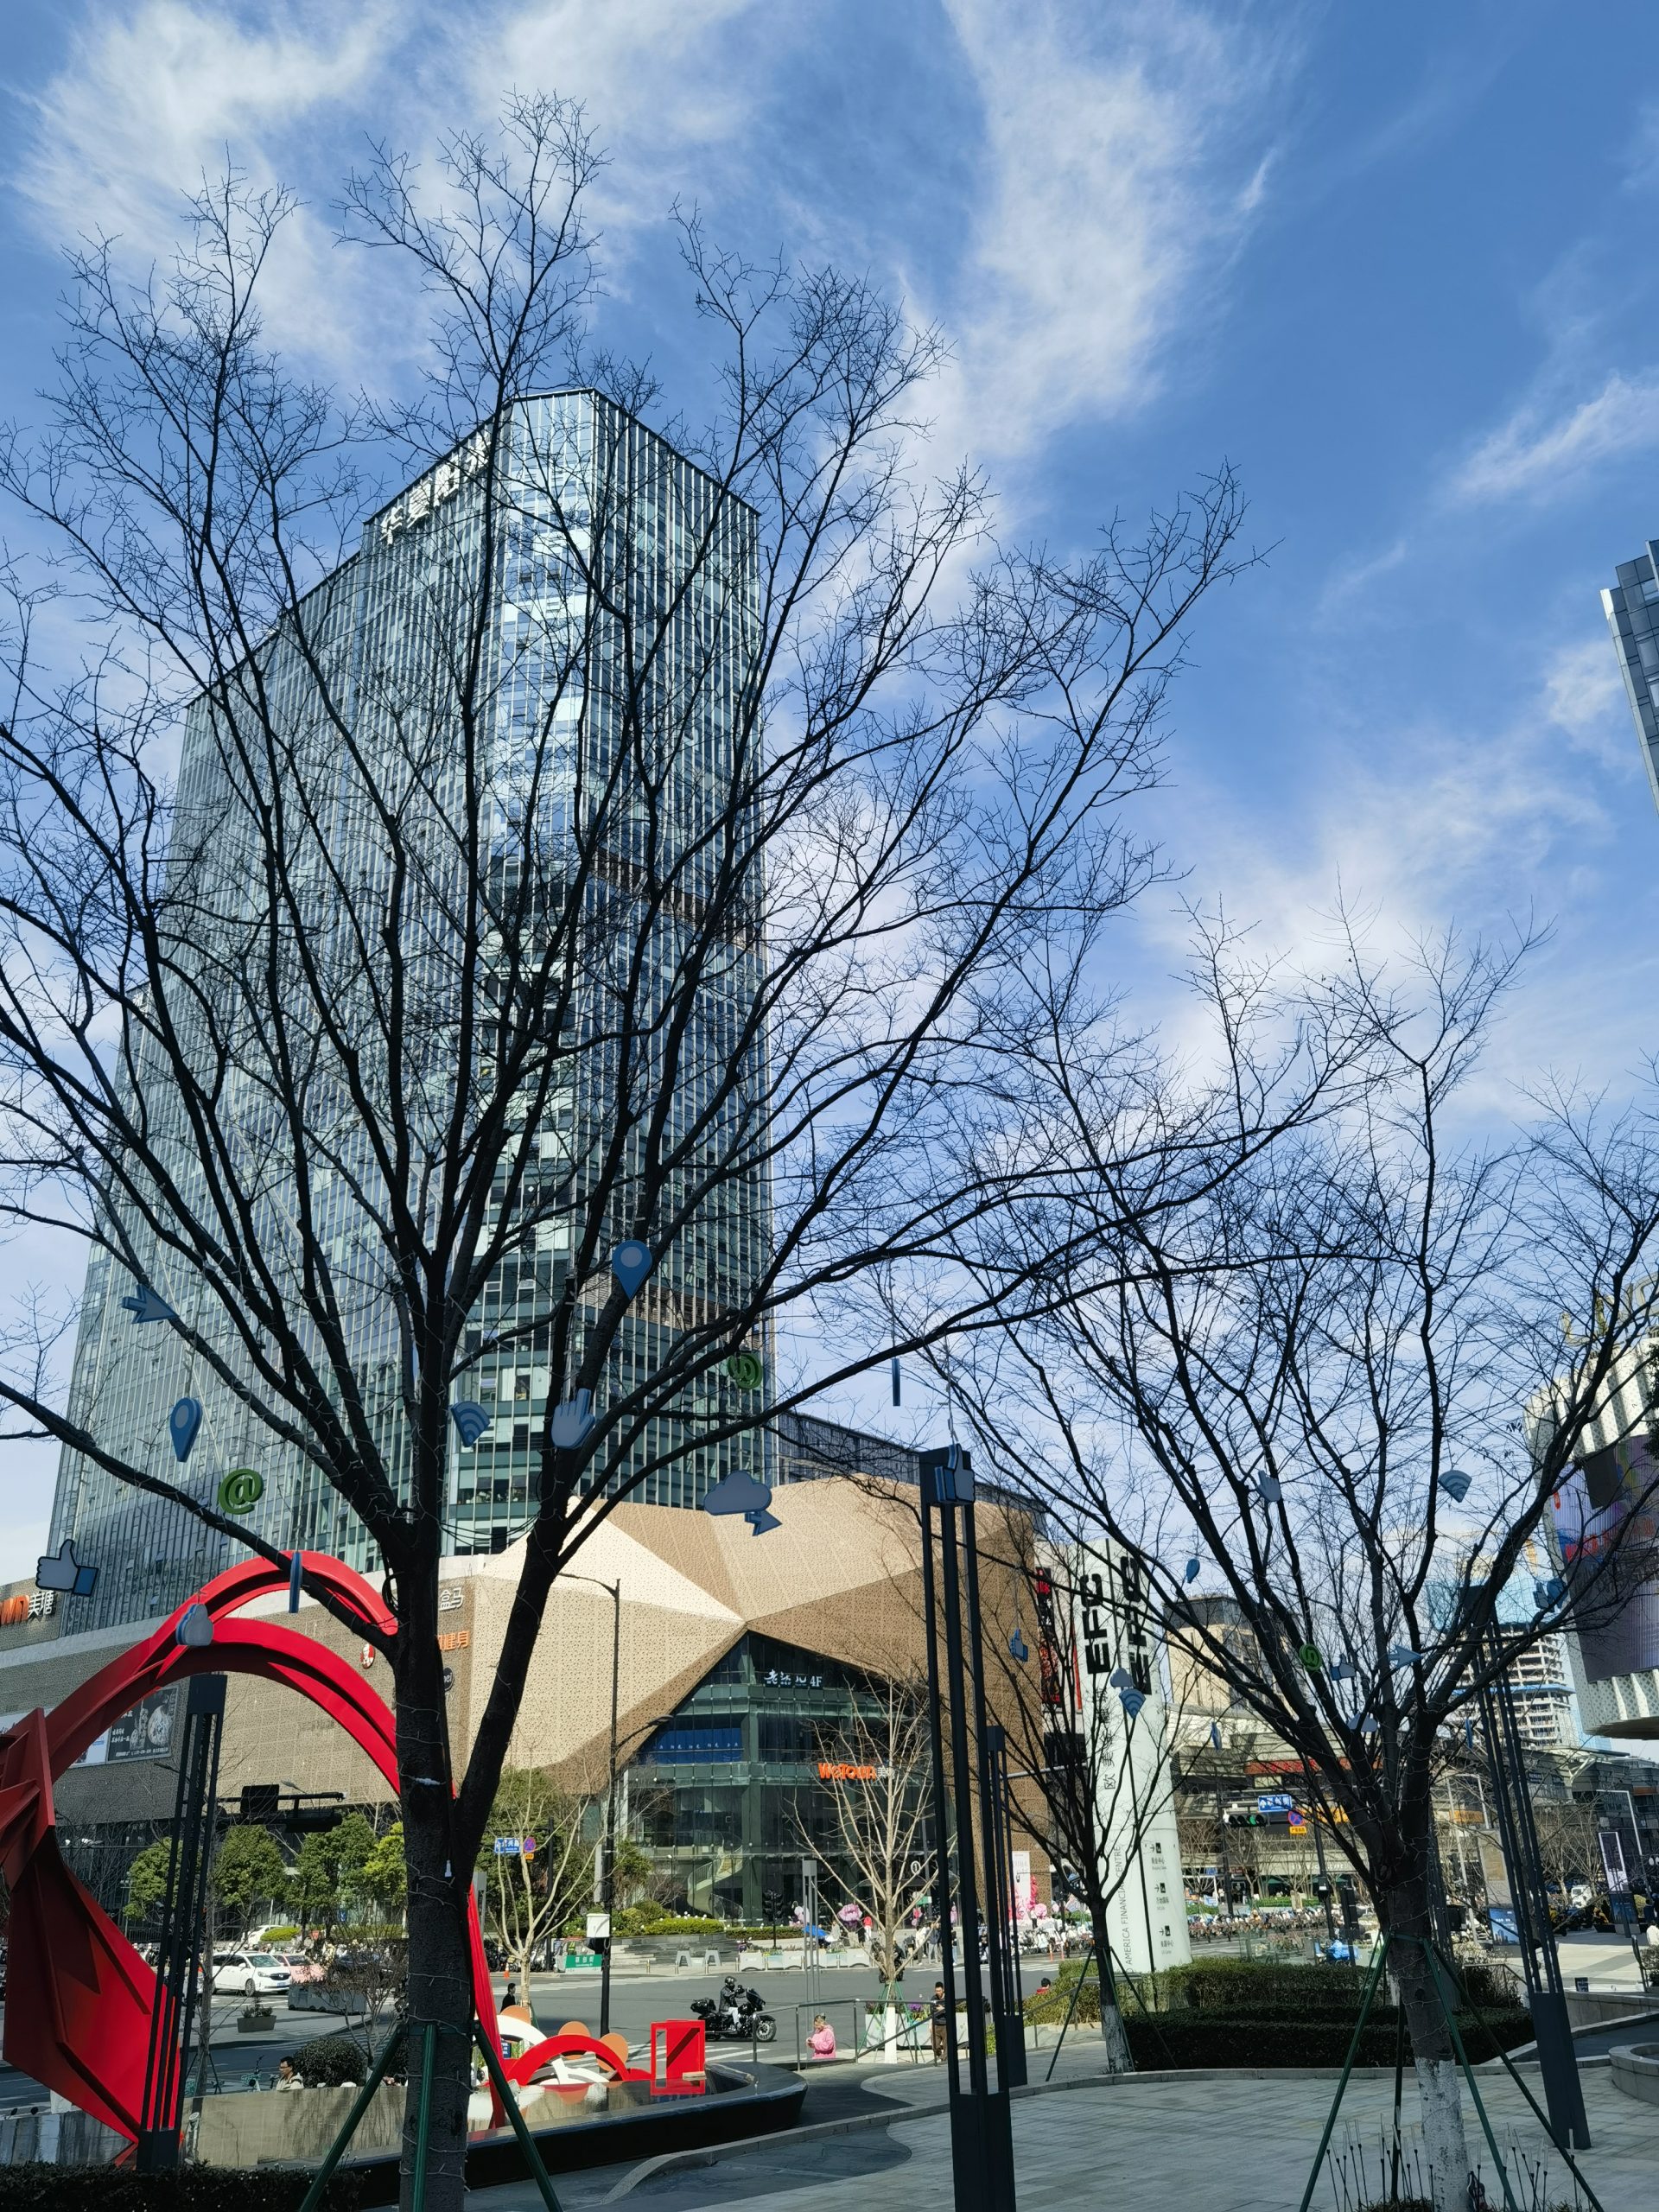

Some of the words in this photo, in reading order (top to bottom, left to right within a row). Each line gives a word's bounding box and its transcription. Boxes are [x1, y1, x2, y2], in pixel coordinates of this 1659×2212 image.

[439, 1587, 465, 1611] 盒马
[1080, 1573, 1111, 1675] EFC
[810, 1675, 823, 1688] 4F
[1095, 1686, 1116, 1790] 欧美金融城
[1113, 1846, 1124, 1878] CENTRE
[1117, 1879, 1128, 1925] FINANCIA
[1122, 1927, 1134, 1966] AMERICA
